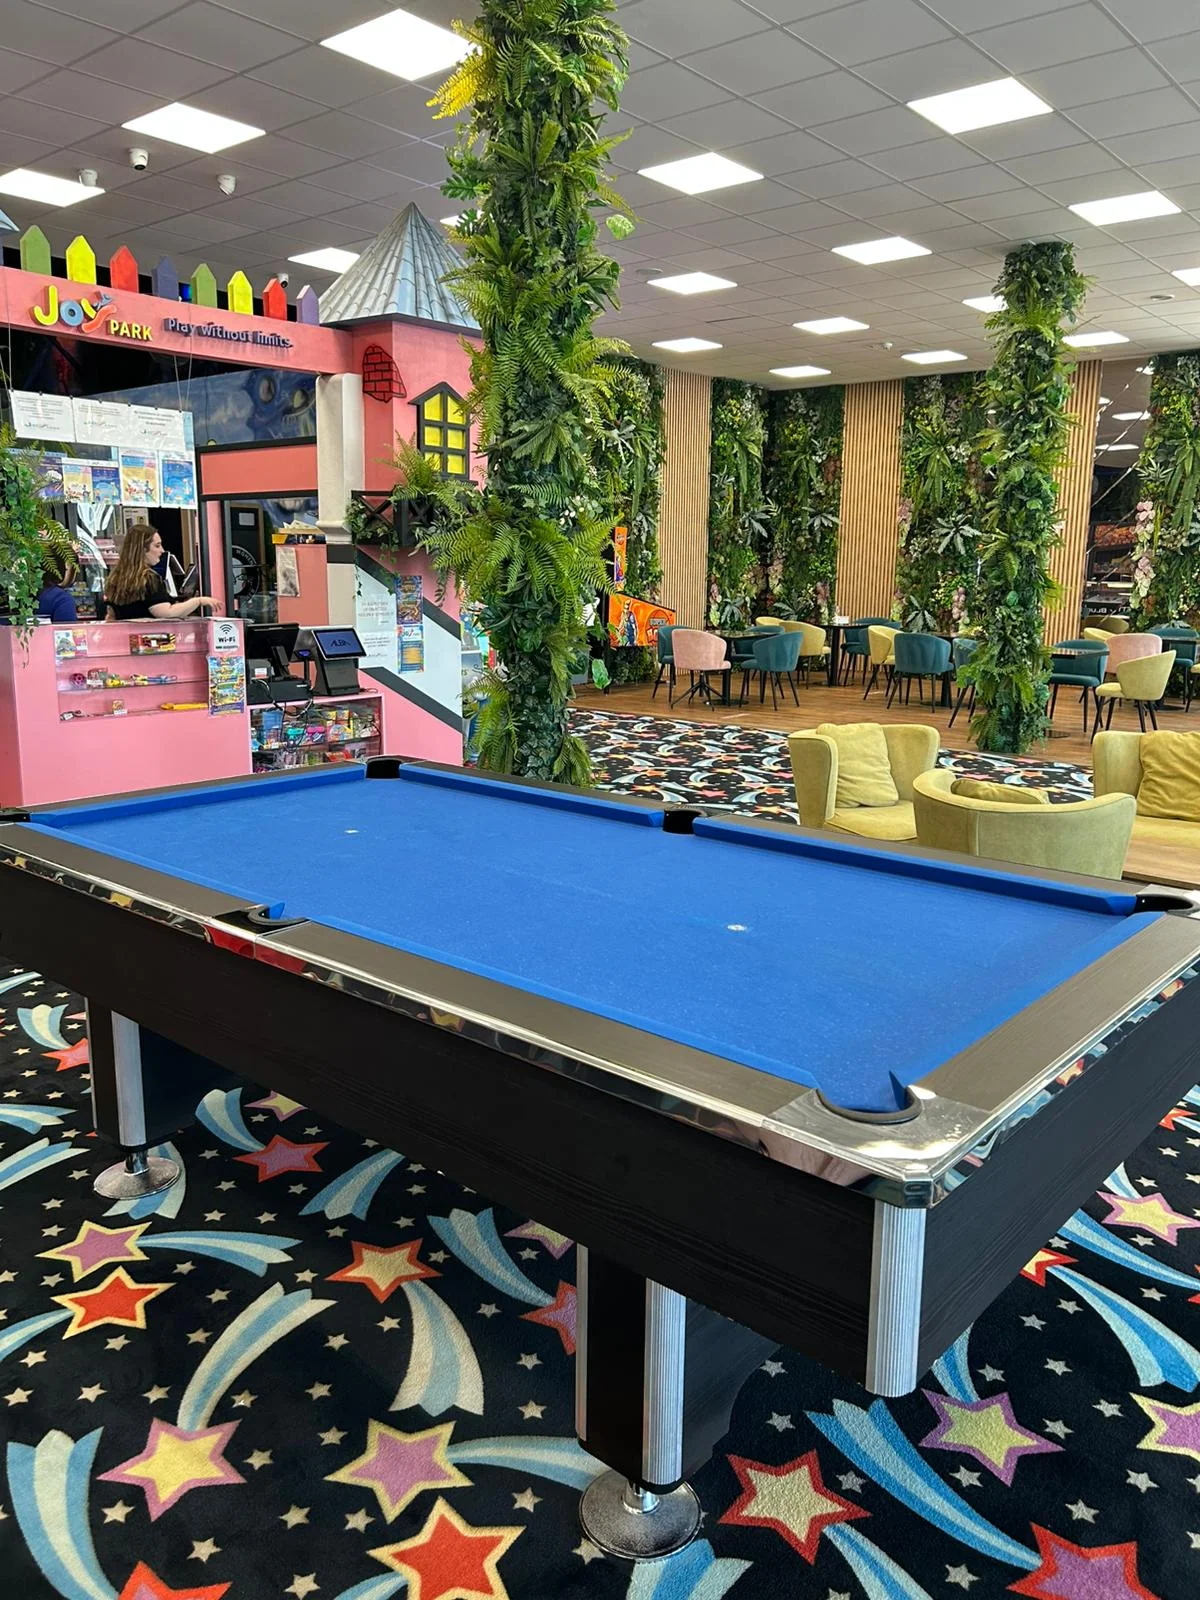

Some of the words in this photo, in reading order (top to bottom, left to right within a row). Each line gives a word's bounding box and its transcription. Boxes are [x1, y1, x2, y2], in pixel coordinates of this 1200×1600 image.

[109, 319, 153, 341] PARK
[165, 318, 197, 338] Play
[200, 322, 253, 344] without
